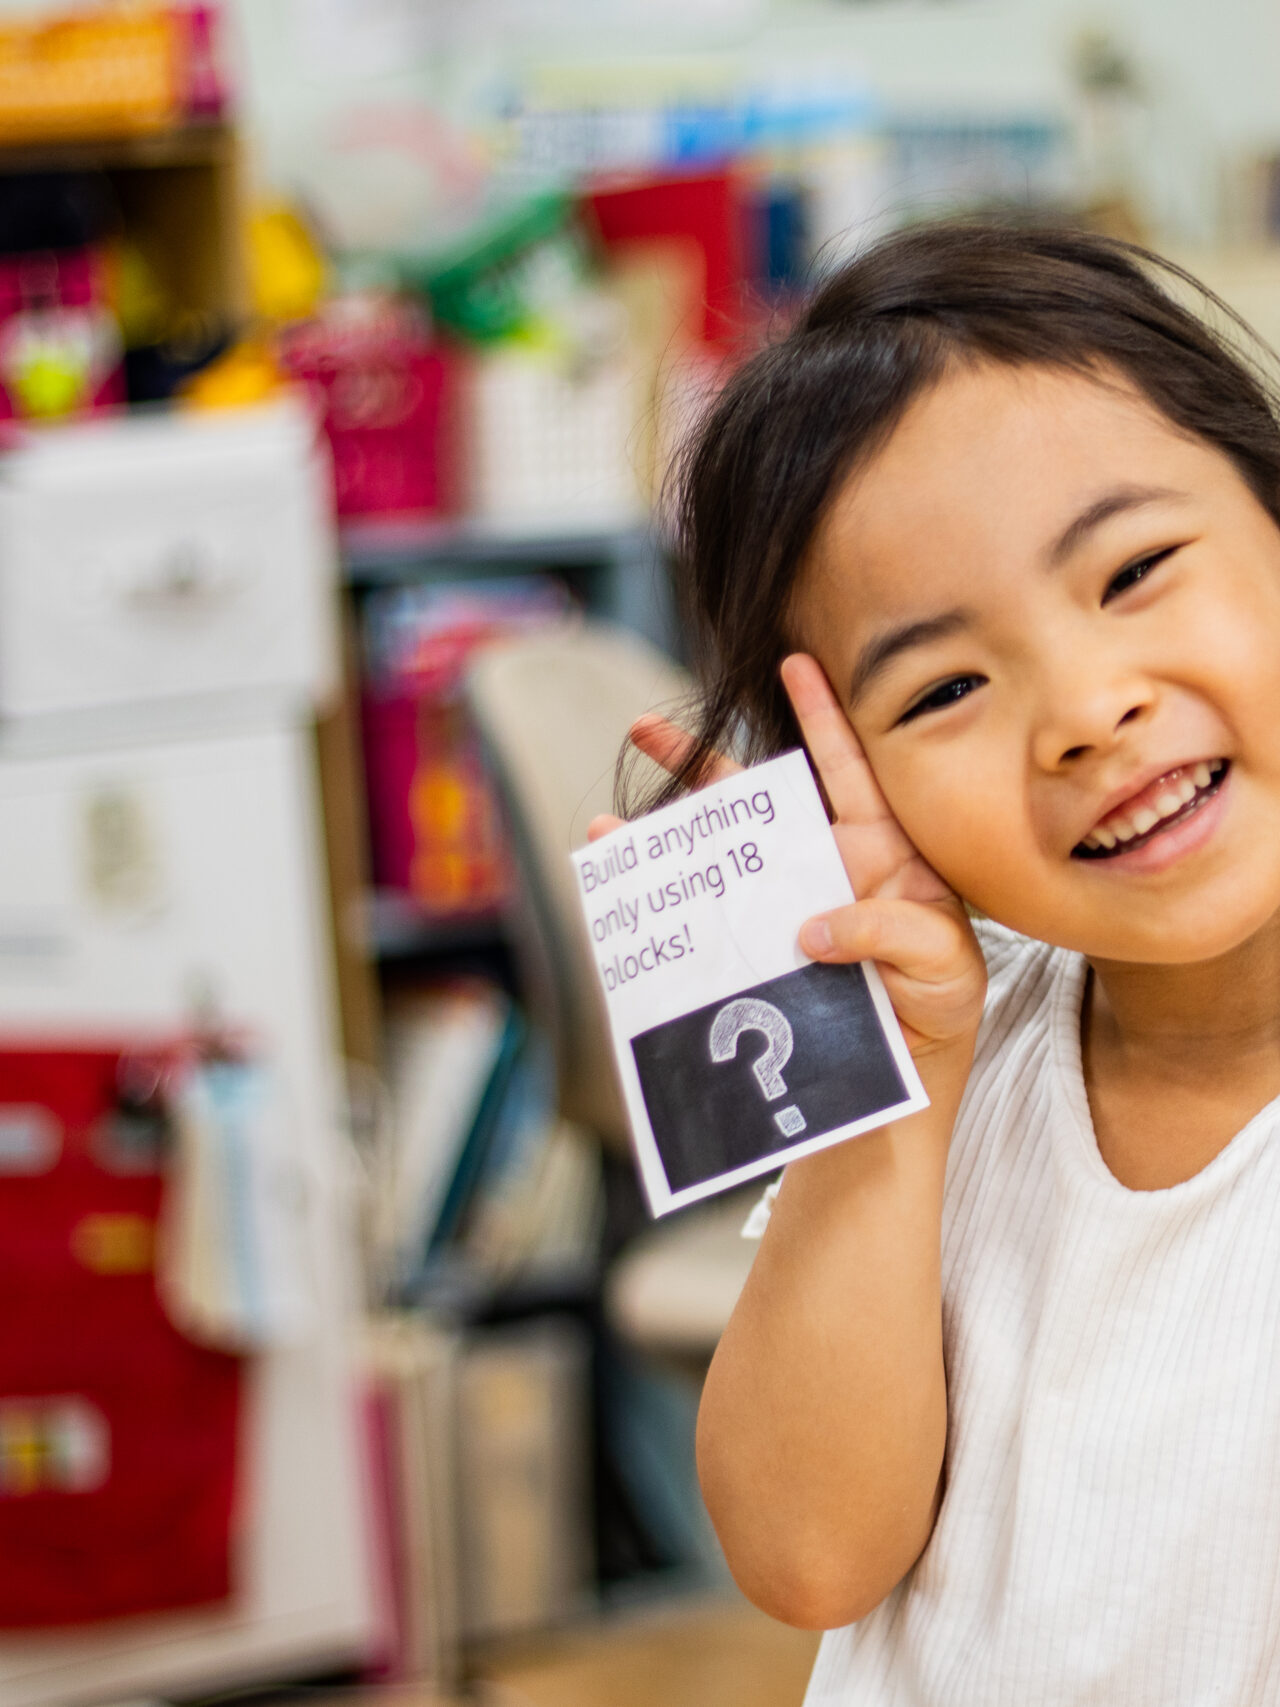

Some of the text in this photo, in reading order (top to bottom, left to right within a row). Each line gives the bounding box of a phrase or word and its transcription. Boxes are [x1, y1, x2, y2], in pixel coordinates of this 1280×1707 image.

[580, 789, 776, 893] Build anything
[592, 842, 765, 942] only using 18
[602, 923, 696, 992] blocks!
